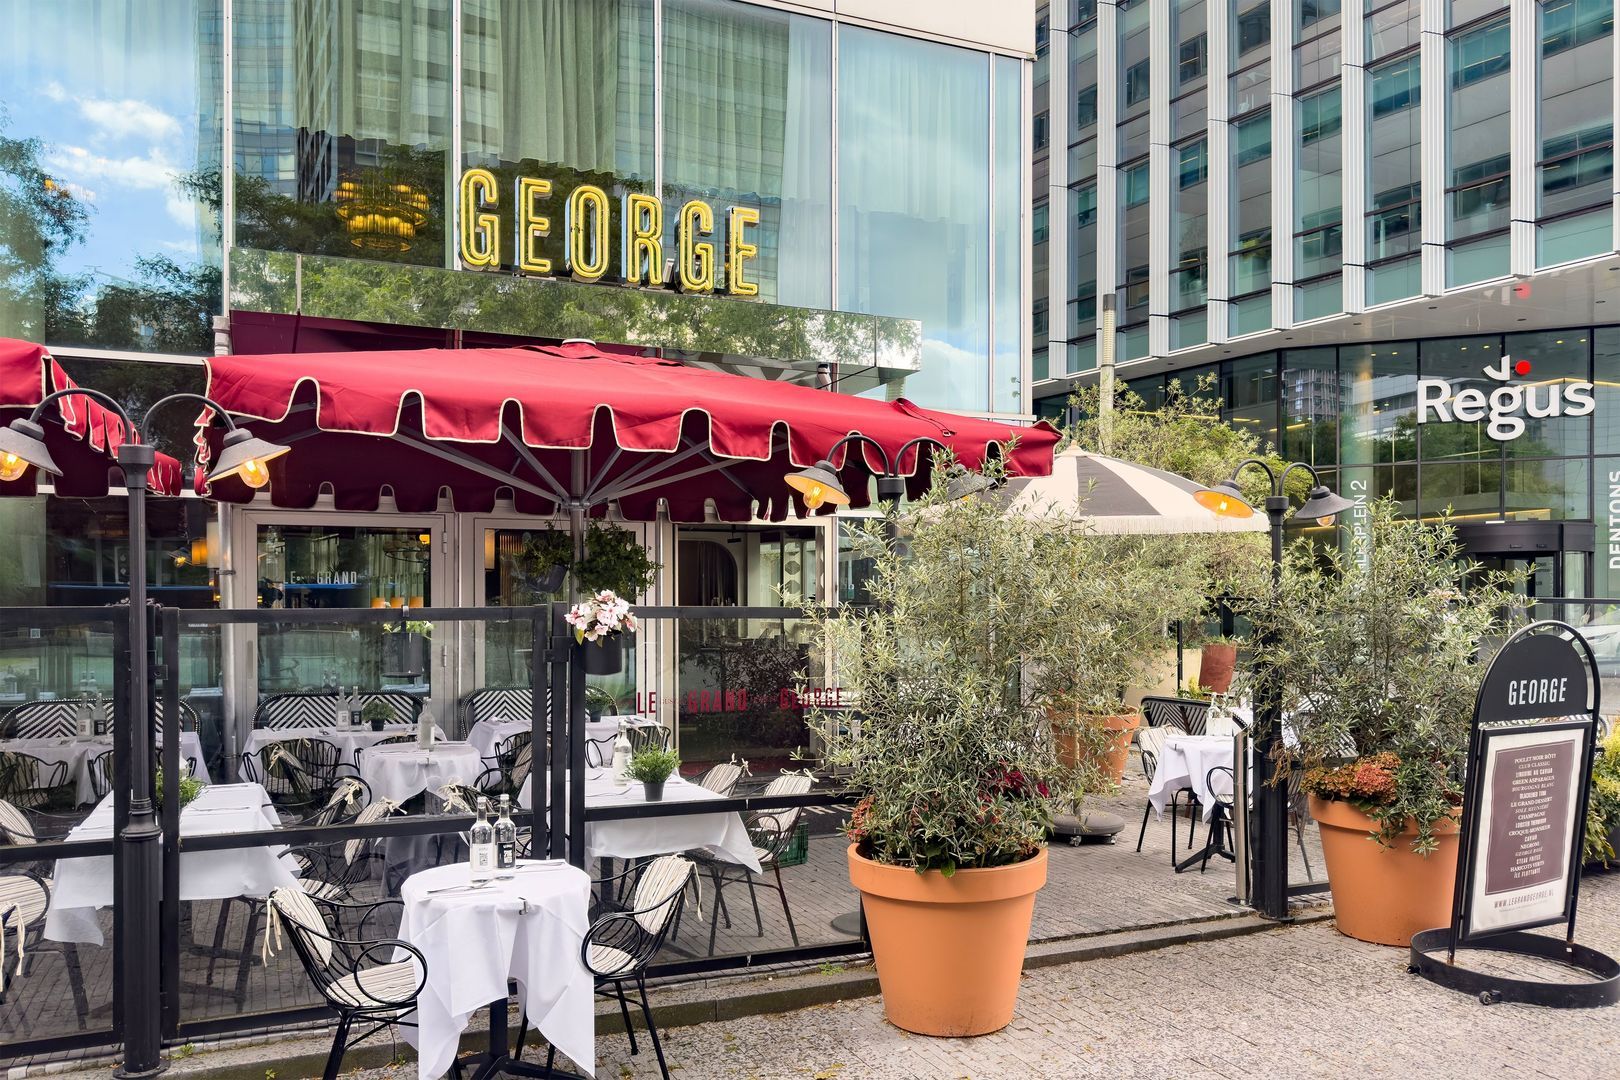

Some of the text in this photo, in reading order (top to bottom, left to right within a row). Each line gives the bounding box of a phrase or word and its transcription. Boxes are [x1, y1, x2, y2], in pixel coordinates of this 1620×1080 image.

[458, 168, 760, 297] GEORGE
[1416, 378, 1596, 442] Regus
[1350, 479, 1367, 491] 2
[1609, 470, 1620, 570] DENTONS
[316, 570, 358, 585] GRAND
[637, 691, 657, 714] LE
[687, 687, 748, 714] GRAND
[1508, 677, 1568, 706] GEORGE
[1517, 799, 1535, 807] GRAND
[1517, 811, 1546, 820] CHAMPAGNE
[1520, 841, 1540, 849] NEGRONI
